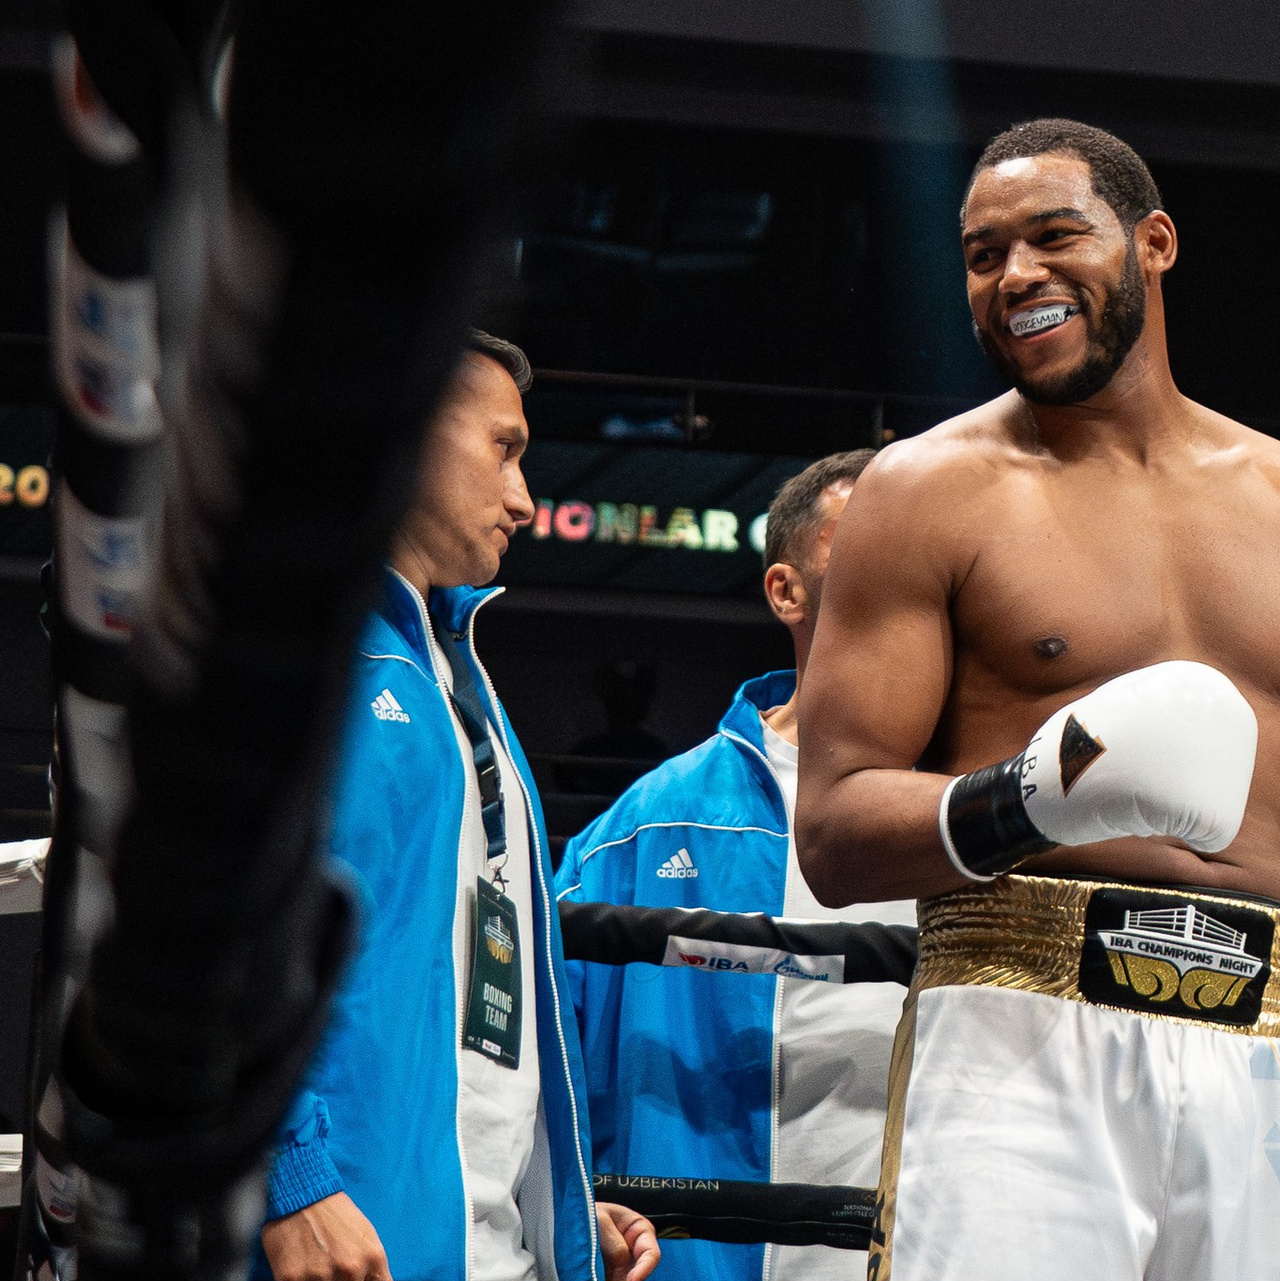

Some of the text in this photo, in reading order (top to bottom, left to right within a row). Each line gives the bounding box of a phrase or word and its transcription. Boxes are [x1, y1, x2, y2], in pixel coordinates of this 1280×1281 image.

[656, 867, 699, 879] adidas
[708, 956, 748, 970] IBA
[1110, 935, 1256, 974] IBA CHAMPIONS NIGHT
[483, 982, 513, 1013] BOXING
[485, 1005, 508, 1032] TEAM
[618, 1176, 719, 1191] UZBEKISTAN
